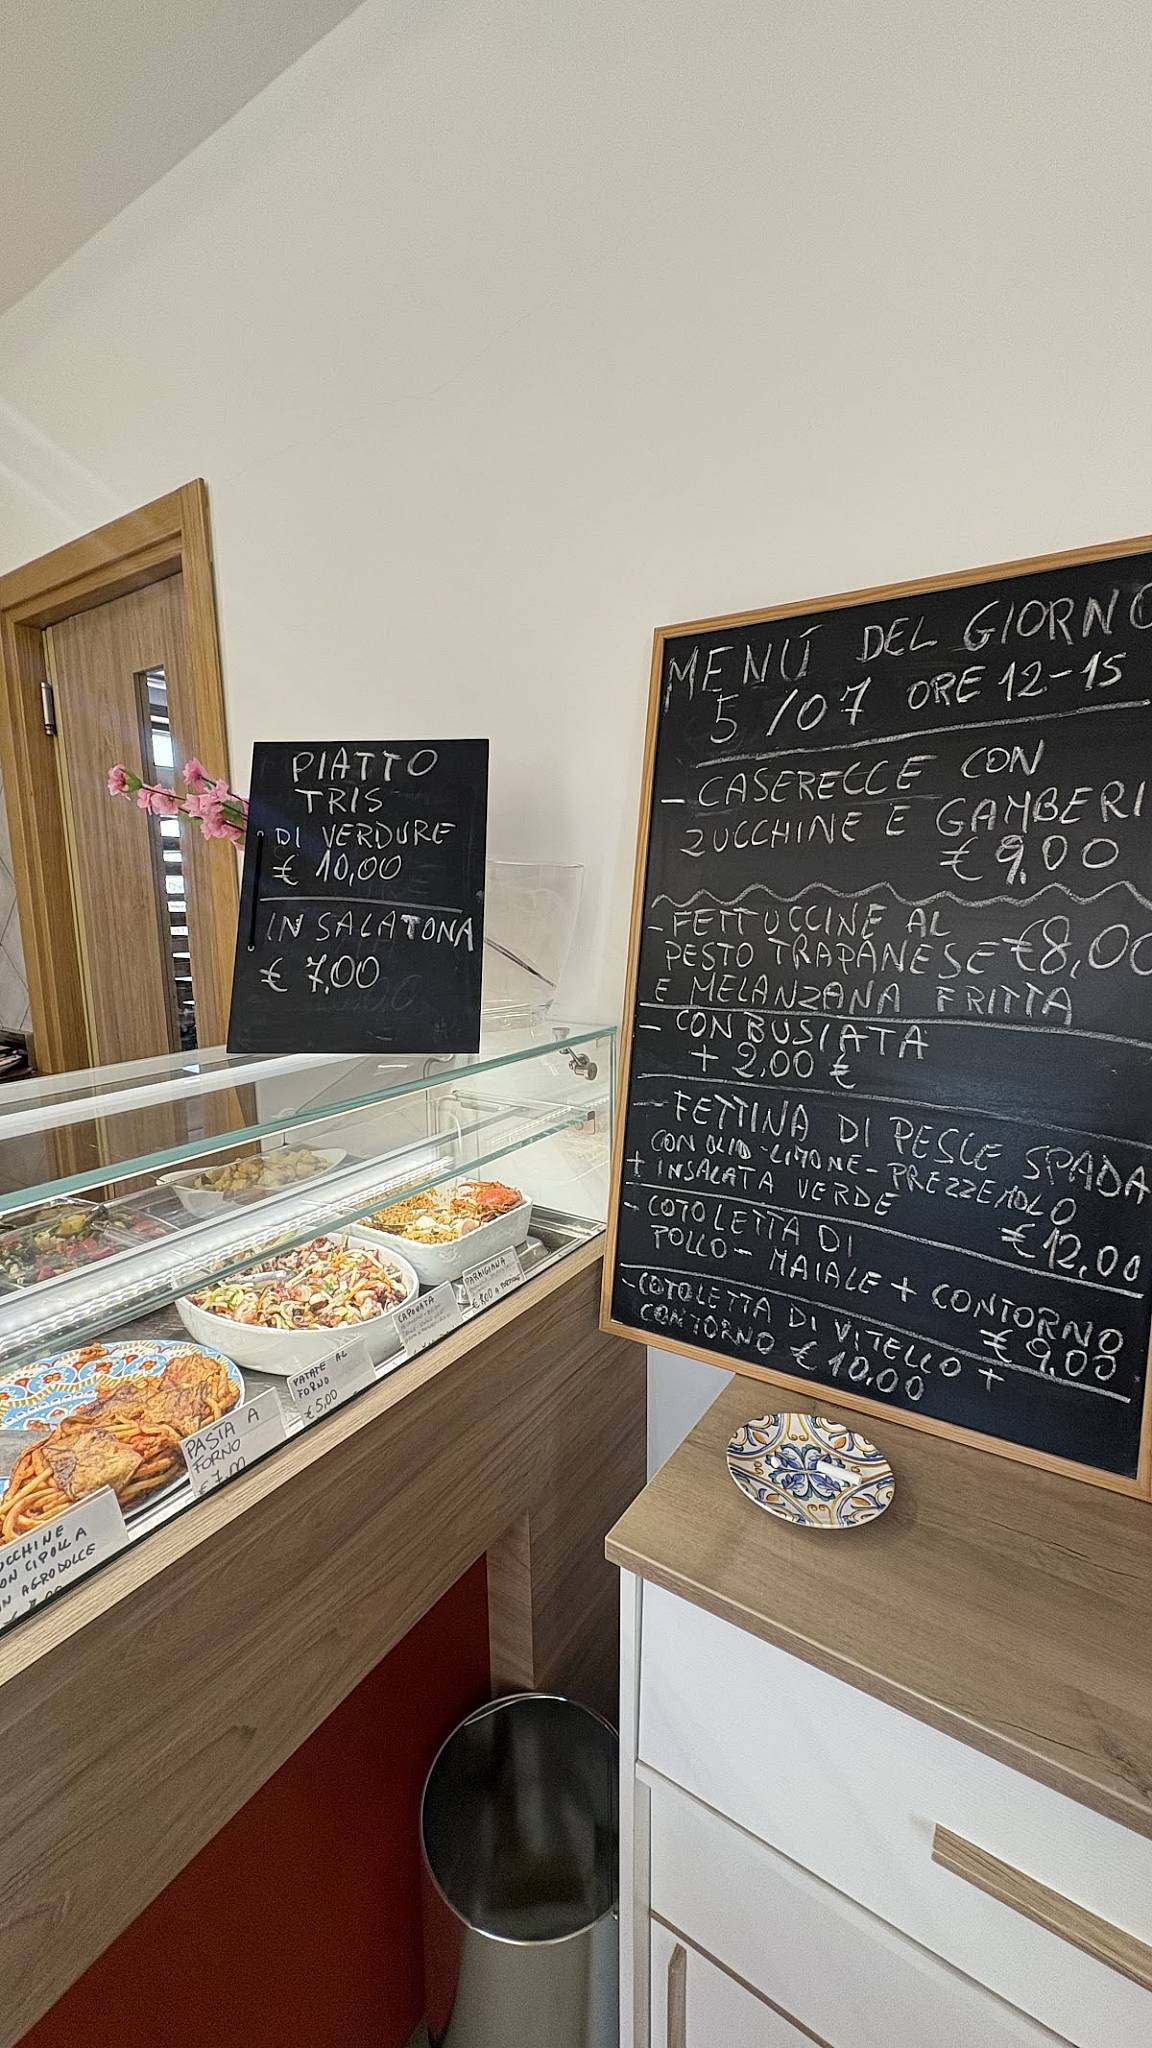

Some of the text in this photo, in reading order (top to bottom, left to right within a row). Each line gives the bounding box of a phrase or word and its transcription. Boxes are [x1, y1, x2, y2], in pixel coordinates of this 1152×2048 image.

[855, 615, 938, 663] DEL
[907, 665, 986, 710] ORE
[293, 747, 438, 782] PIATTO
[698, 755, 938, 807] CASERECCE
[961, 739, 1044, 778] CON
[294, 787, 384, 815] TRIS
[680, 781, 1146, 857] ZUCCHINE E GAMBERI
[276, 820, 456, 849] DI VERDURE
[672, 902, 887, 940] FETTUCCINE
[906, 908, 950, 938] AL
[665, 940, 754, 971] PESTO
[767, 933, 999, 979] TRAPANESE
[655, 972, 1072, 1025] E MELANZANA FRITTA
[676, 1010, 732, 1039] CON
[744, 1011, 929, 1059] BUSIATA
[732, 1041, 815, 1078] 2,00
[651, 1129, 695, 1152] CON
[674, 1090, 809, 1141] FETTINA
[838, 1113, 870, 1148] DI
[890, 1116, 1003, 1171] PESCE
[1022, 1145, 1151, 1204] SPADA
[658, 1159, 775, 1193] INSALATA
[798, 1178, 900, 1215] VERDE
[648, 1195, 800, 1246] COTOLETTA
[817, 1225, 852, 1257] DI
[638, 1272, 771, 1323] COTOLETTA
[788, 1303, 817, 1331] DI
[834, 1319, 962, 1377] VITELLO
[769, 1249, 882, 1293] MAIALE
[931, 1284, 1124, 1355] CONTORNO
[292, 1351, 348, 1387] PATATE AL
[297, 1377, 329, 1398] FORNO
[185, 1408, 259, 1459] PASTA A
[192, 1439, 240, 1473] FORNO
[0, 1569, 17, 1588] ON
[22, 1543, 96, 1596] AGRODOLCE
